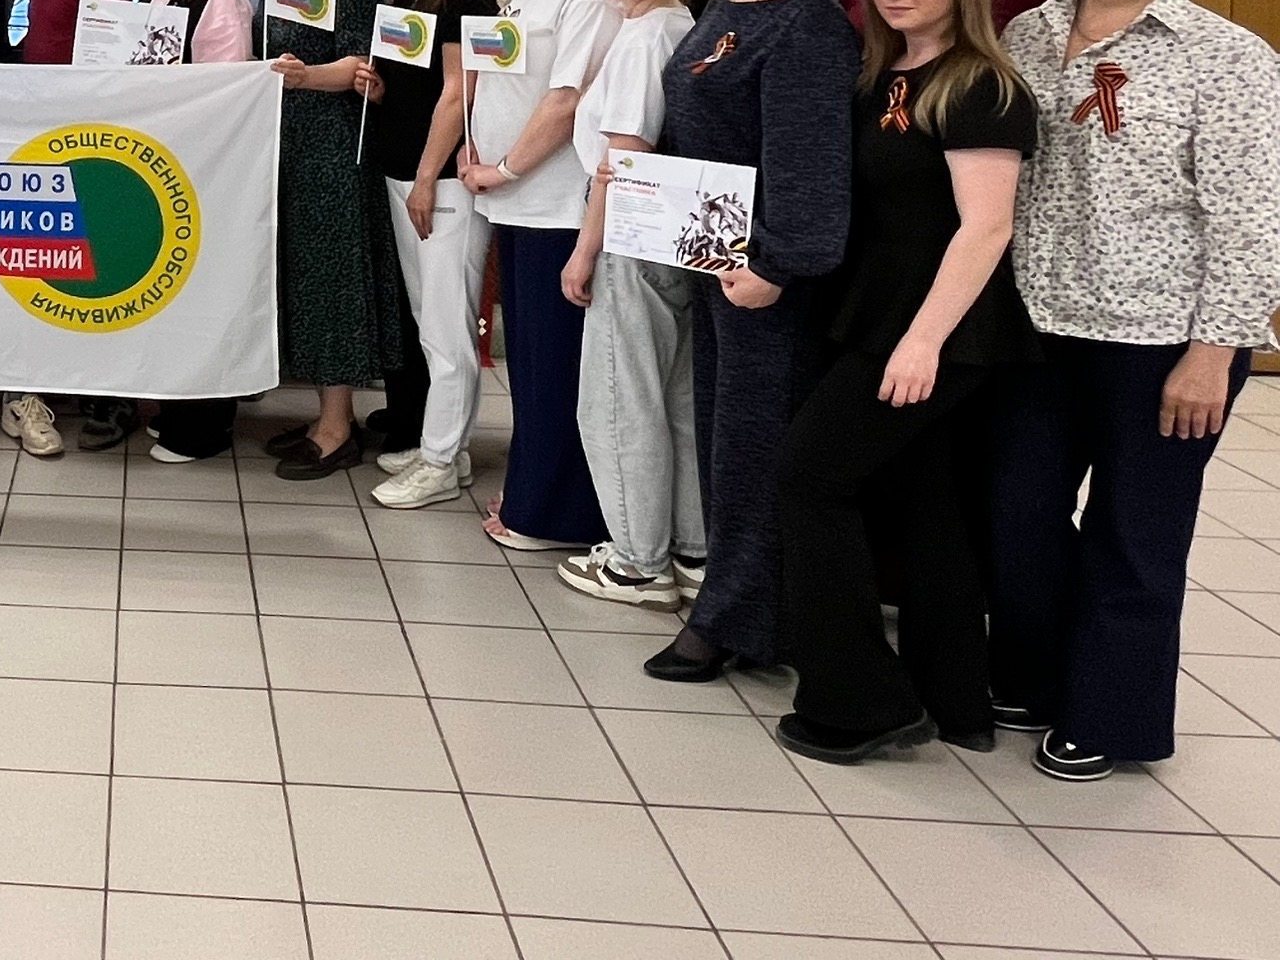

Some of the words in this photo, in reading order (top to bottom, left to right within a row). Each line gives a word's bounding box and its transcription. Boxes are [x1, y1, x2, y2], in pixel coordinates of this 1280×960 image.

[48, 132, 192, 240] ОБЩЕСТВЕННОГО
[614, 177, 660, 188] СЕРТИФИКАТ
[29, 247, 188, 324] ОБСЛУЖИВАНИЯ
